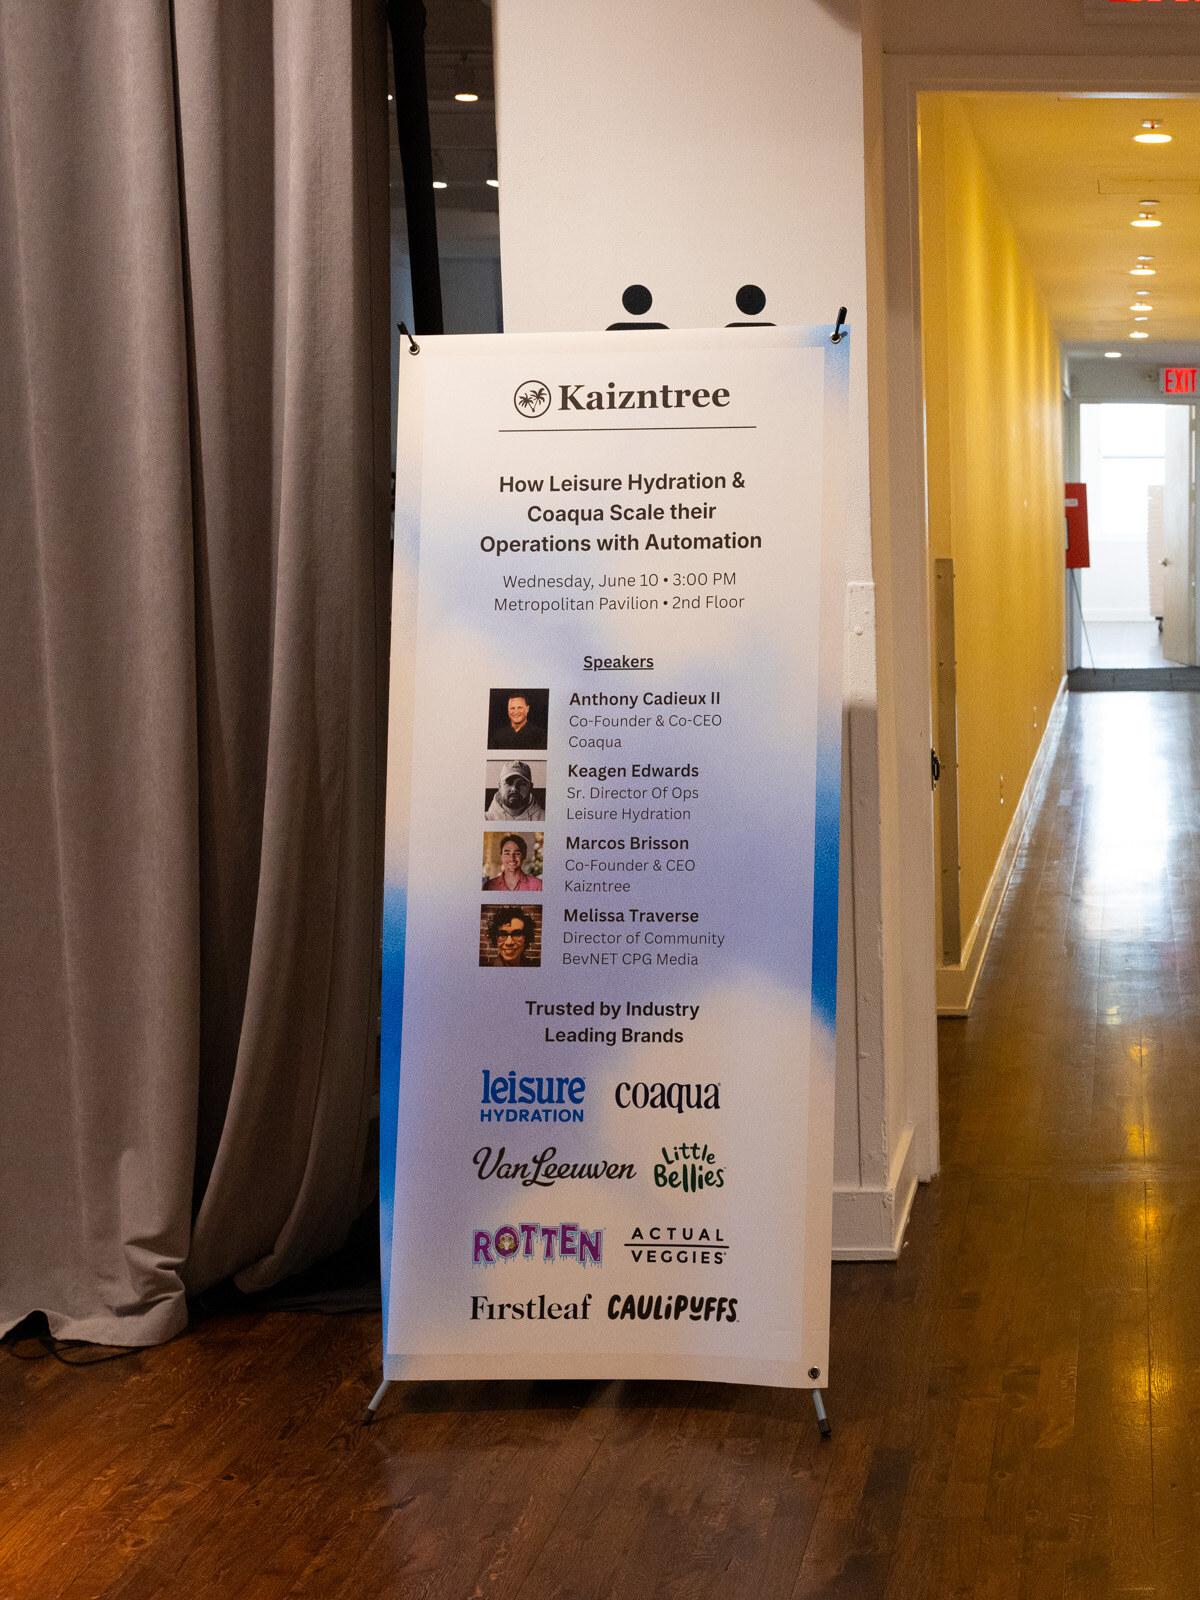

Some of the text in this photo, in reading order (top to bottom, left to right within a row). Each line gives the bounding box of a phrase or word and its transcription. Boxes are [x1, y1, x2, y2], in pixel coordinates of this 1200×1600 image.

[1165, 368, 1197, 393] EXIT
[558, 382, 731, 411] Kaizntree
[499, 471, 746, 494] How Leisure Hydration &
[527, 503, 716, 525] Coaqua Scale their
[479, 532, 762, 555] Operations with Automation
[503, 572, 736, 590] Wednesday, June 10 3:00 PM
[494, 594, 745, 613] Metropolitan Pavilion 2nd Floor
[583, 655, 654, 671] Speakers
[569, 692, 720, 708] Anthony Cadieux II
[569, 715, 722, 728] Co-Founder & Co-CEO
[569, 736, 622, 750] Coaqua
[568, 764, 699, 781] Keagen Edwards
[567, 787, 699, 801] Sr. Director Of Ops
[567, 808, 691, 823] Leisure Hydration
[566, 836, 689, 850] Marcos Brisson
[565, 859, 696, 872] Co-Founder & CEO
[565, 880, 631, 893] Kaizntree
[564, 909, 699, 923] Melissa Traverse
[563, 932, 725, 947] Director of Community
[563, 953, 699, 966] BevNET CPG Media
[525, 1001, 700, 1020] Trusted by Industry
[545, 1028, 684, 1046] Leading Brands
[481, 1070, 586, 1104] leisure
[480, 1109, 584, 1123] HYDRATION
[662, 1143, 715, 1165] Little
[654, 1164, 726, 1193] Bellies
[631, 1227, 724, 1242] ACTUAL
[472, 1222, 606, 1269] ROTTEN
[470, 1294, 592, 1320] Firstleaf
